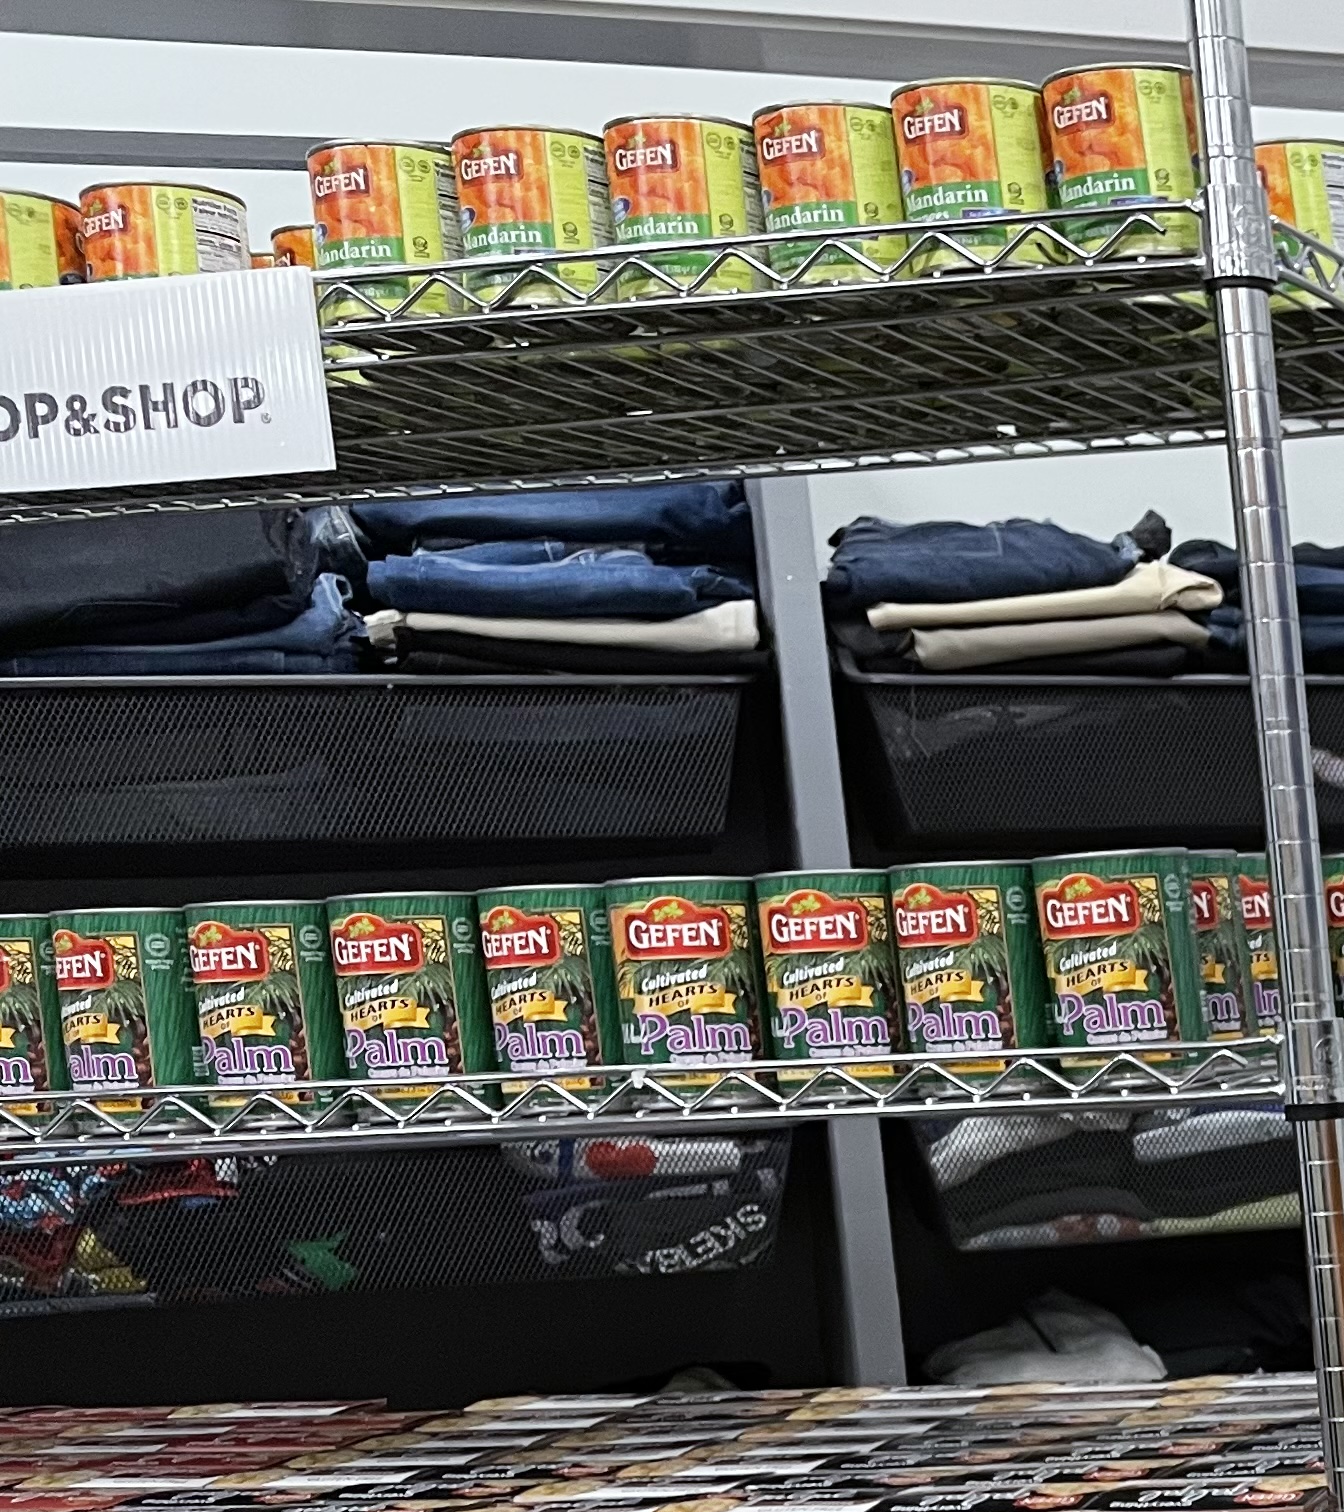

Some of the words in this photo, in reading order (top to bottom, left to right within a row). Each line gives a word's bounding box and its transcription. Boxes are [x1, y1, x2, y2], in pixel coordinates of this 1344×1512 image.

[903, 109, 961, 137] GEFEN
[461, 154, 517, 180] GEFEN
[615, 144, 675, 170] GEFEN
[771, 913, 858, 942] GEFEN
[1047, 898, 1135, 928] GEFEN
[629, 919, 720, 950] GEFEN
[1060, 942, 1118, 972] Cultivated
[642, 965, 709, 992] Cultivated
[1064, 961, 1129, 988] HEARTS
[648, 981, 718, 1009] HEARTS
[1062, 993, 1167, 1032] Palm
[642, 1015, 750, 1053] Palm
[784, 1008, 888, 1047] Palm
